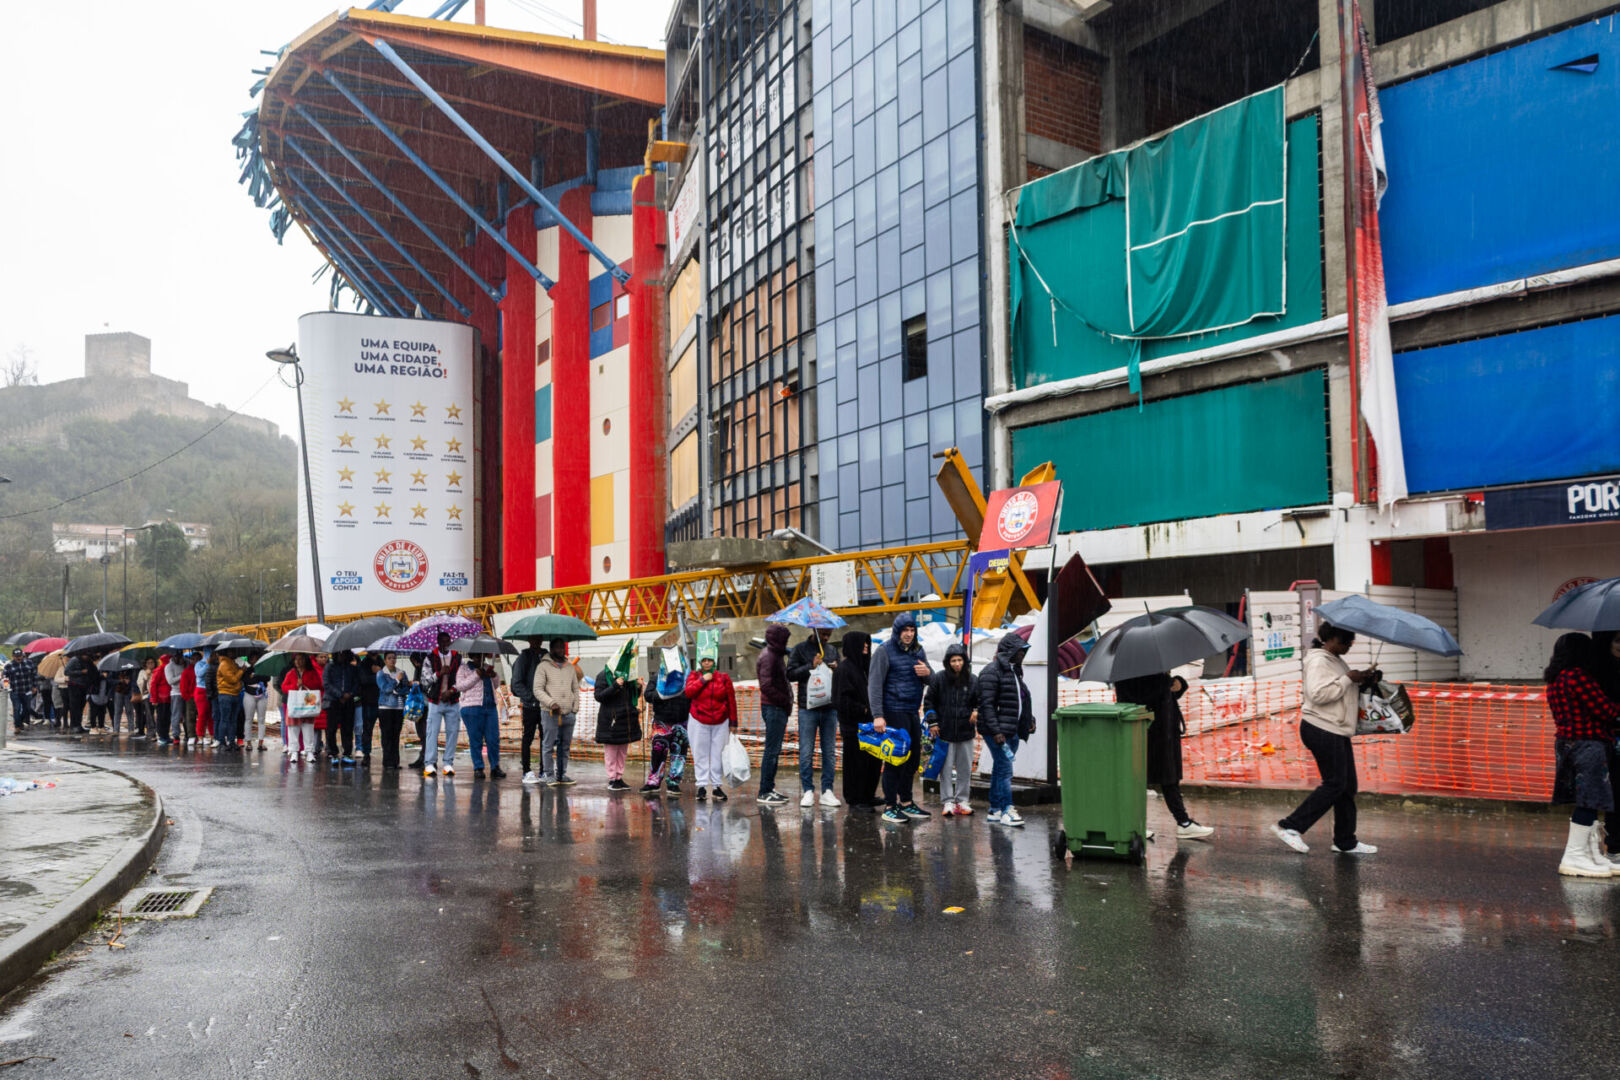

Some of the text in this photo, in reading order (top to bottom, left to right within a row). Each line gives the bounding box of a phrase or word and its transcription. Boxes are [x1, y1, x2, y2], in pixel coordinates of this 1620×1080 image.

[361, 338, 441, 354] UMA EQUIPA,
[361, 351, 441, 367] UMA CIDADE,
[355, 363, 447, 378] UMA REGIÃO!
[1567, 481, 1620, 514] POR
[396, 542, 405, 550] DE
[385, 579, 418, 589] PORTUGAL
